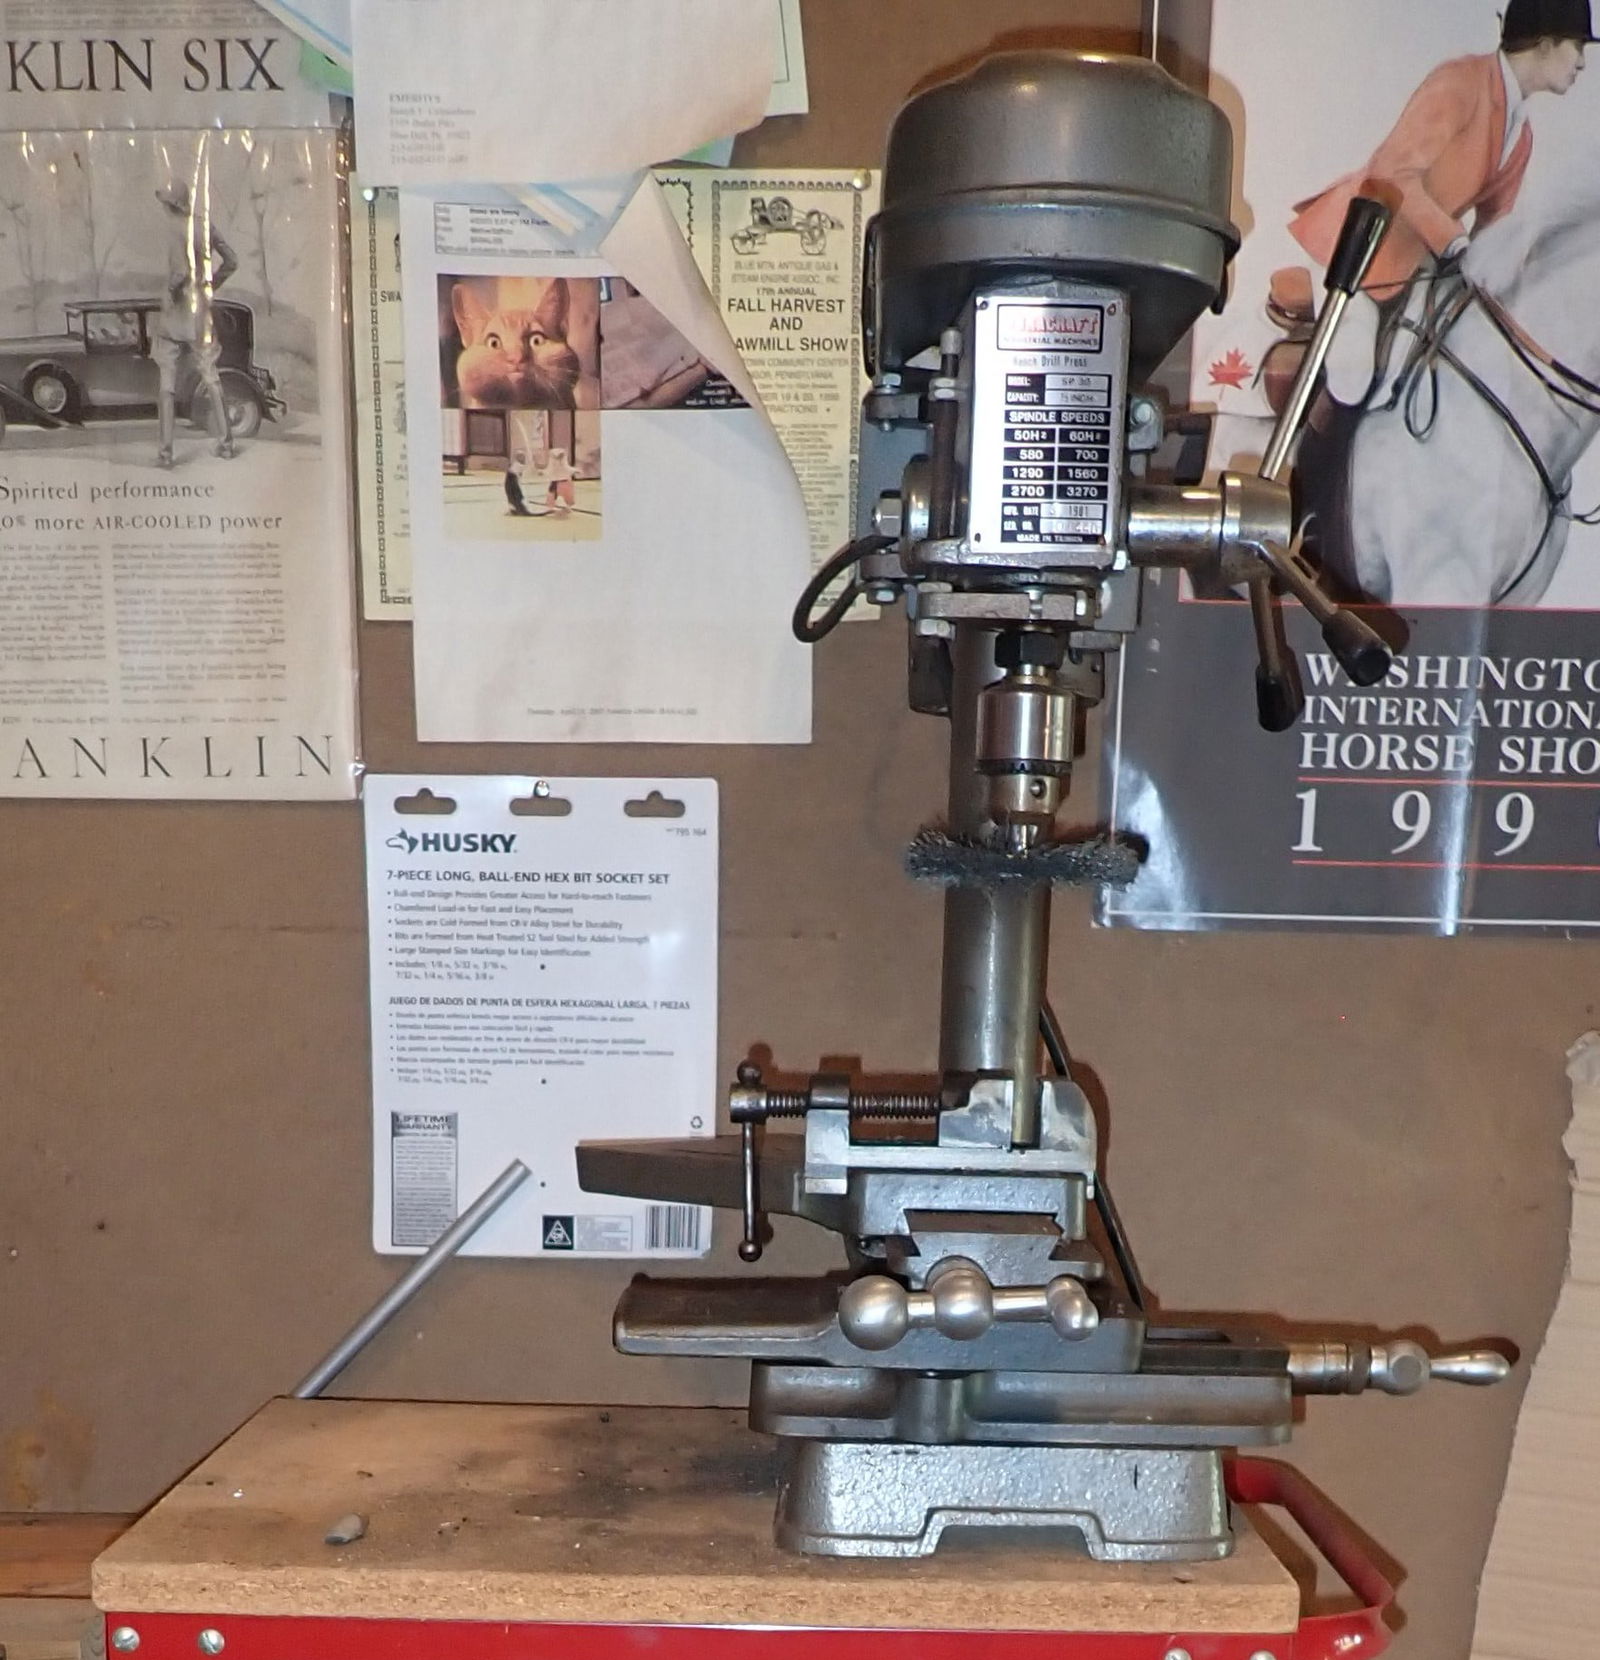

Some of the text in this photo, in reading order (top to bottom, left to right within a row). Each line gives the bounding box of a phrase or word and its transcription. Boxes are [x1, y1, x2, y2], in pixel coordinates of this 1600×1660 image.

[6, 37, 285, 93] KLIN SIX
[778, 288, 817, 297] ANNUAL
[728, 299, 846, 314] FALL HARVEST
[769, 317, 803, 331] AND
[735, 337, 849, 352] AWMILL SHOW
[1041, 355, 1061, 367] Drill
[1064, 355, 1088, 368] Press
[1009, 410, 1105, 423] SPINDLE SPEEDS
[1019, 449, 1044, 460] 580
[1075, 450, 1099, 461] 700
[1012, 467, 1044, 478] 1290
[1068, 468, 1098, 479] 1560
[89, 479, 216, 503] performance
[1010, 485, 1045, 496] 2700
[1066, 486, 1098, 497] 3270
[35, 515, 283, 534] more AIR-COOLED power
[1016, 534, 1040, 543] MADE
[1042, 534, 1052, 543] IN
[1305, 653, 1600, 692] WSHINGT
[1303, 694, 1600, 730] INTERNATION
[13, 734, 334, 779] ANKLIN
[1299, 732, 1475, 771] HORSE
[421, 832, 517, 853] HUSKY
[387, 870, 432, 881] 7-PIECE
[479, 871, 541, 882] BALL-END
[545, 872, 570, 883] HEX
[574, 872, 592, 883] BIT
[596, 872, 645, 883] SOCKET
[649, 873, 671, 884] SET
